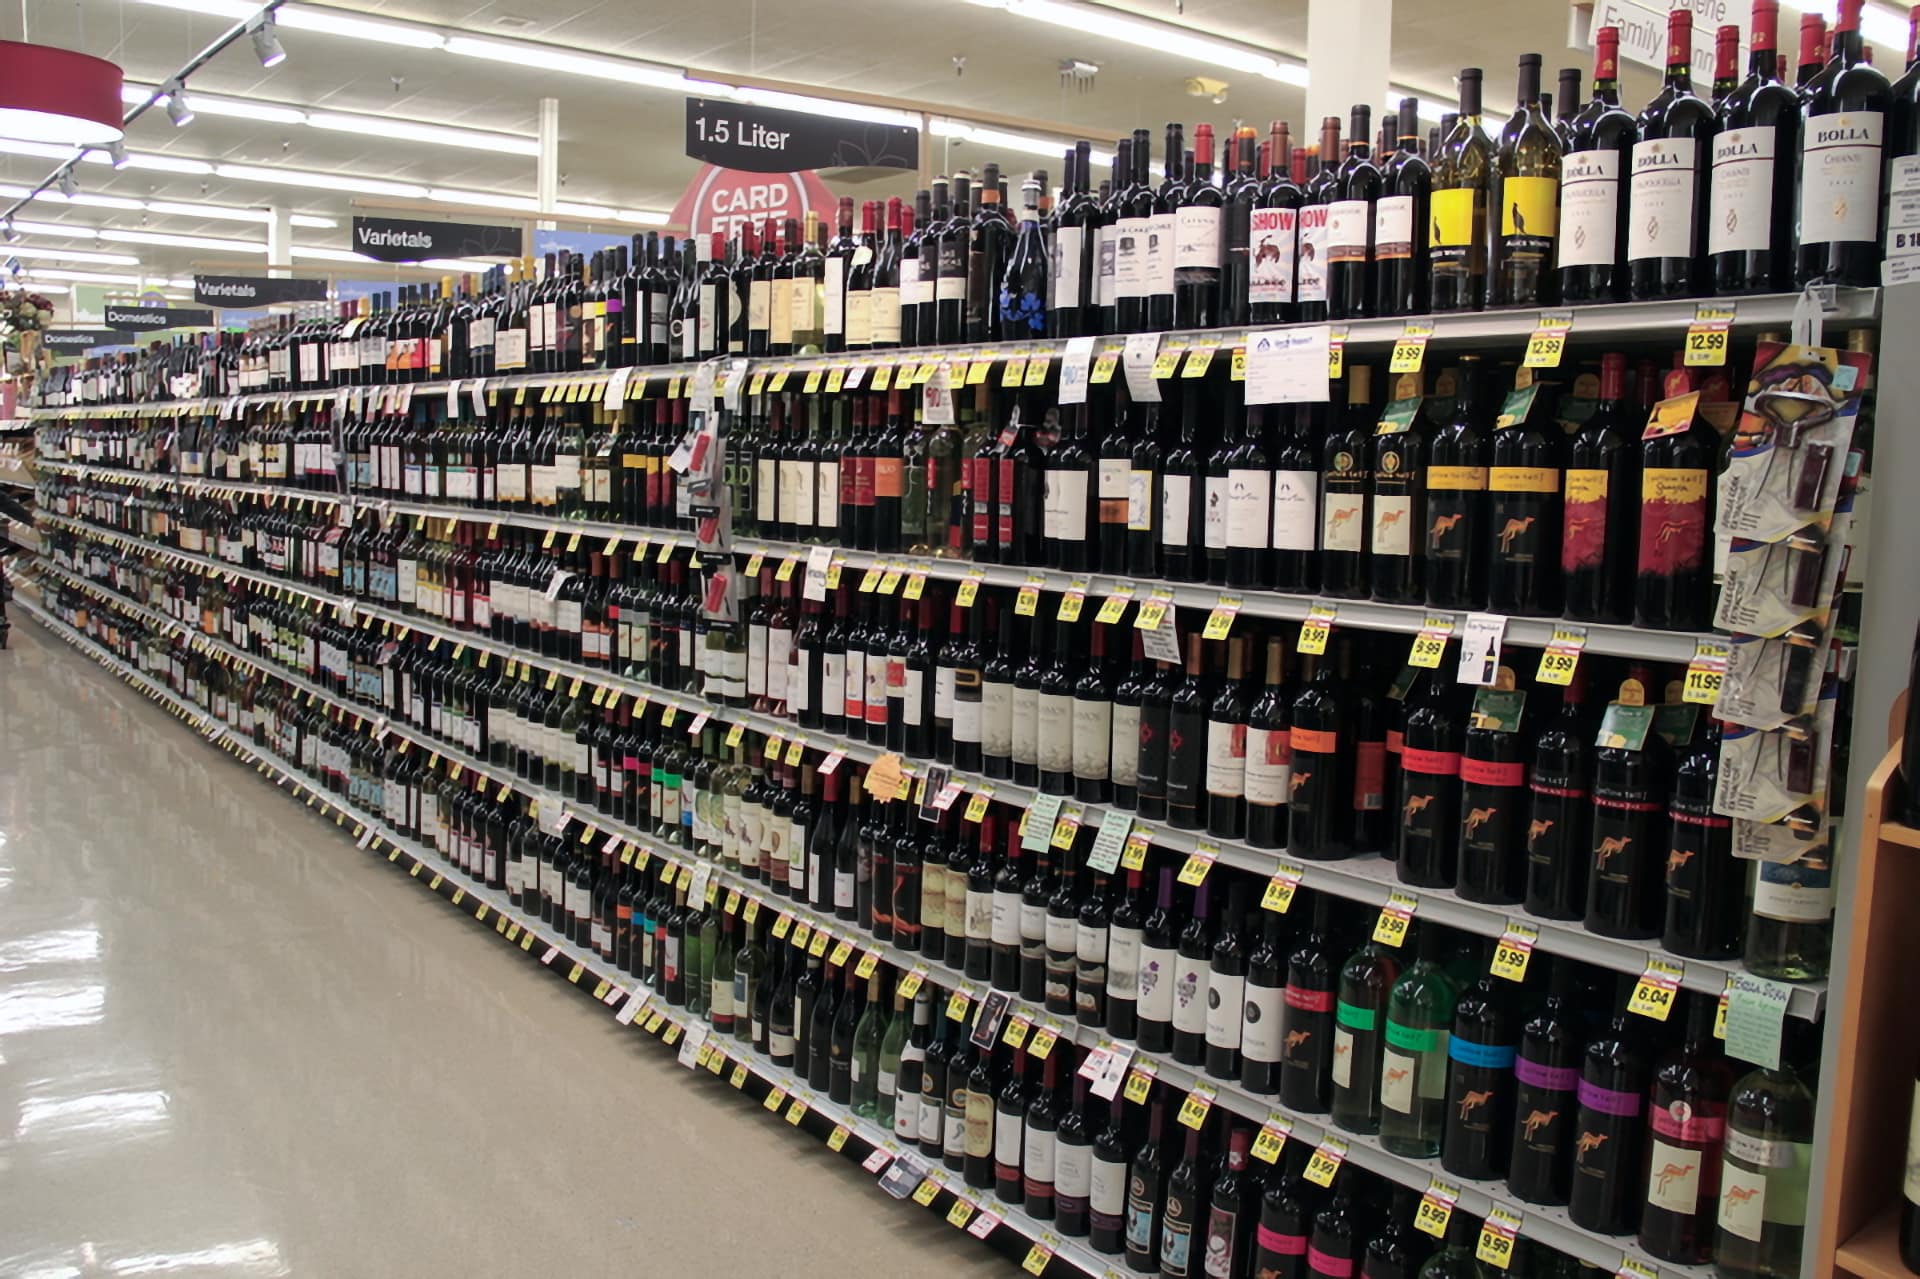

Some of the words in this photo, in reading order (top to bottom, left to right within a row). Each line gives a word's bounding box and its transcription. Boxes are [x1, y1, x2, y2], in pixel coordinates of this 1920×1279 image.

[1604, 6, 1663, 59] Family
[695, 117, 729, 144] 1.5
[737, 121, 790, 150] Liter
[1818, 128, 1869, 143] BOLLA
[1717, 143, 1758, 158] BOLLA
[1638, 153, 1680, 168] BOLLA
[711, 183, 788, 214] CARD
[1252, 212, 1294, 231] SHOW
[358, 227, 432, 249] Varietals
[199, 282, 256, 298] Varietals
[108, 311, 166, 325] Domestics
[44, 333, 94, 345] Domestics
[1690, 334, 1724, 350] 12.99
[1545, 655, 1573, 671] 9.99
[1498, 949, 1525, 967] 9.99
[1638, 986, 1669, 1006] 6.04
[1311, 1157, 1335, 1175] 9.99
[1421, 1204, 1446, 1224] 9.99
[1483, 1233, 1509, 1254] 9.99
